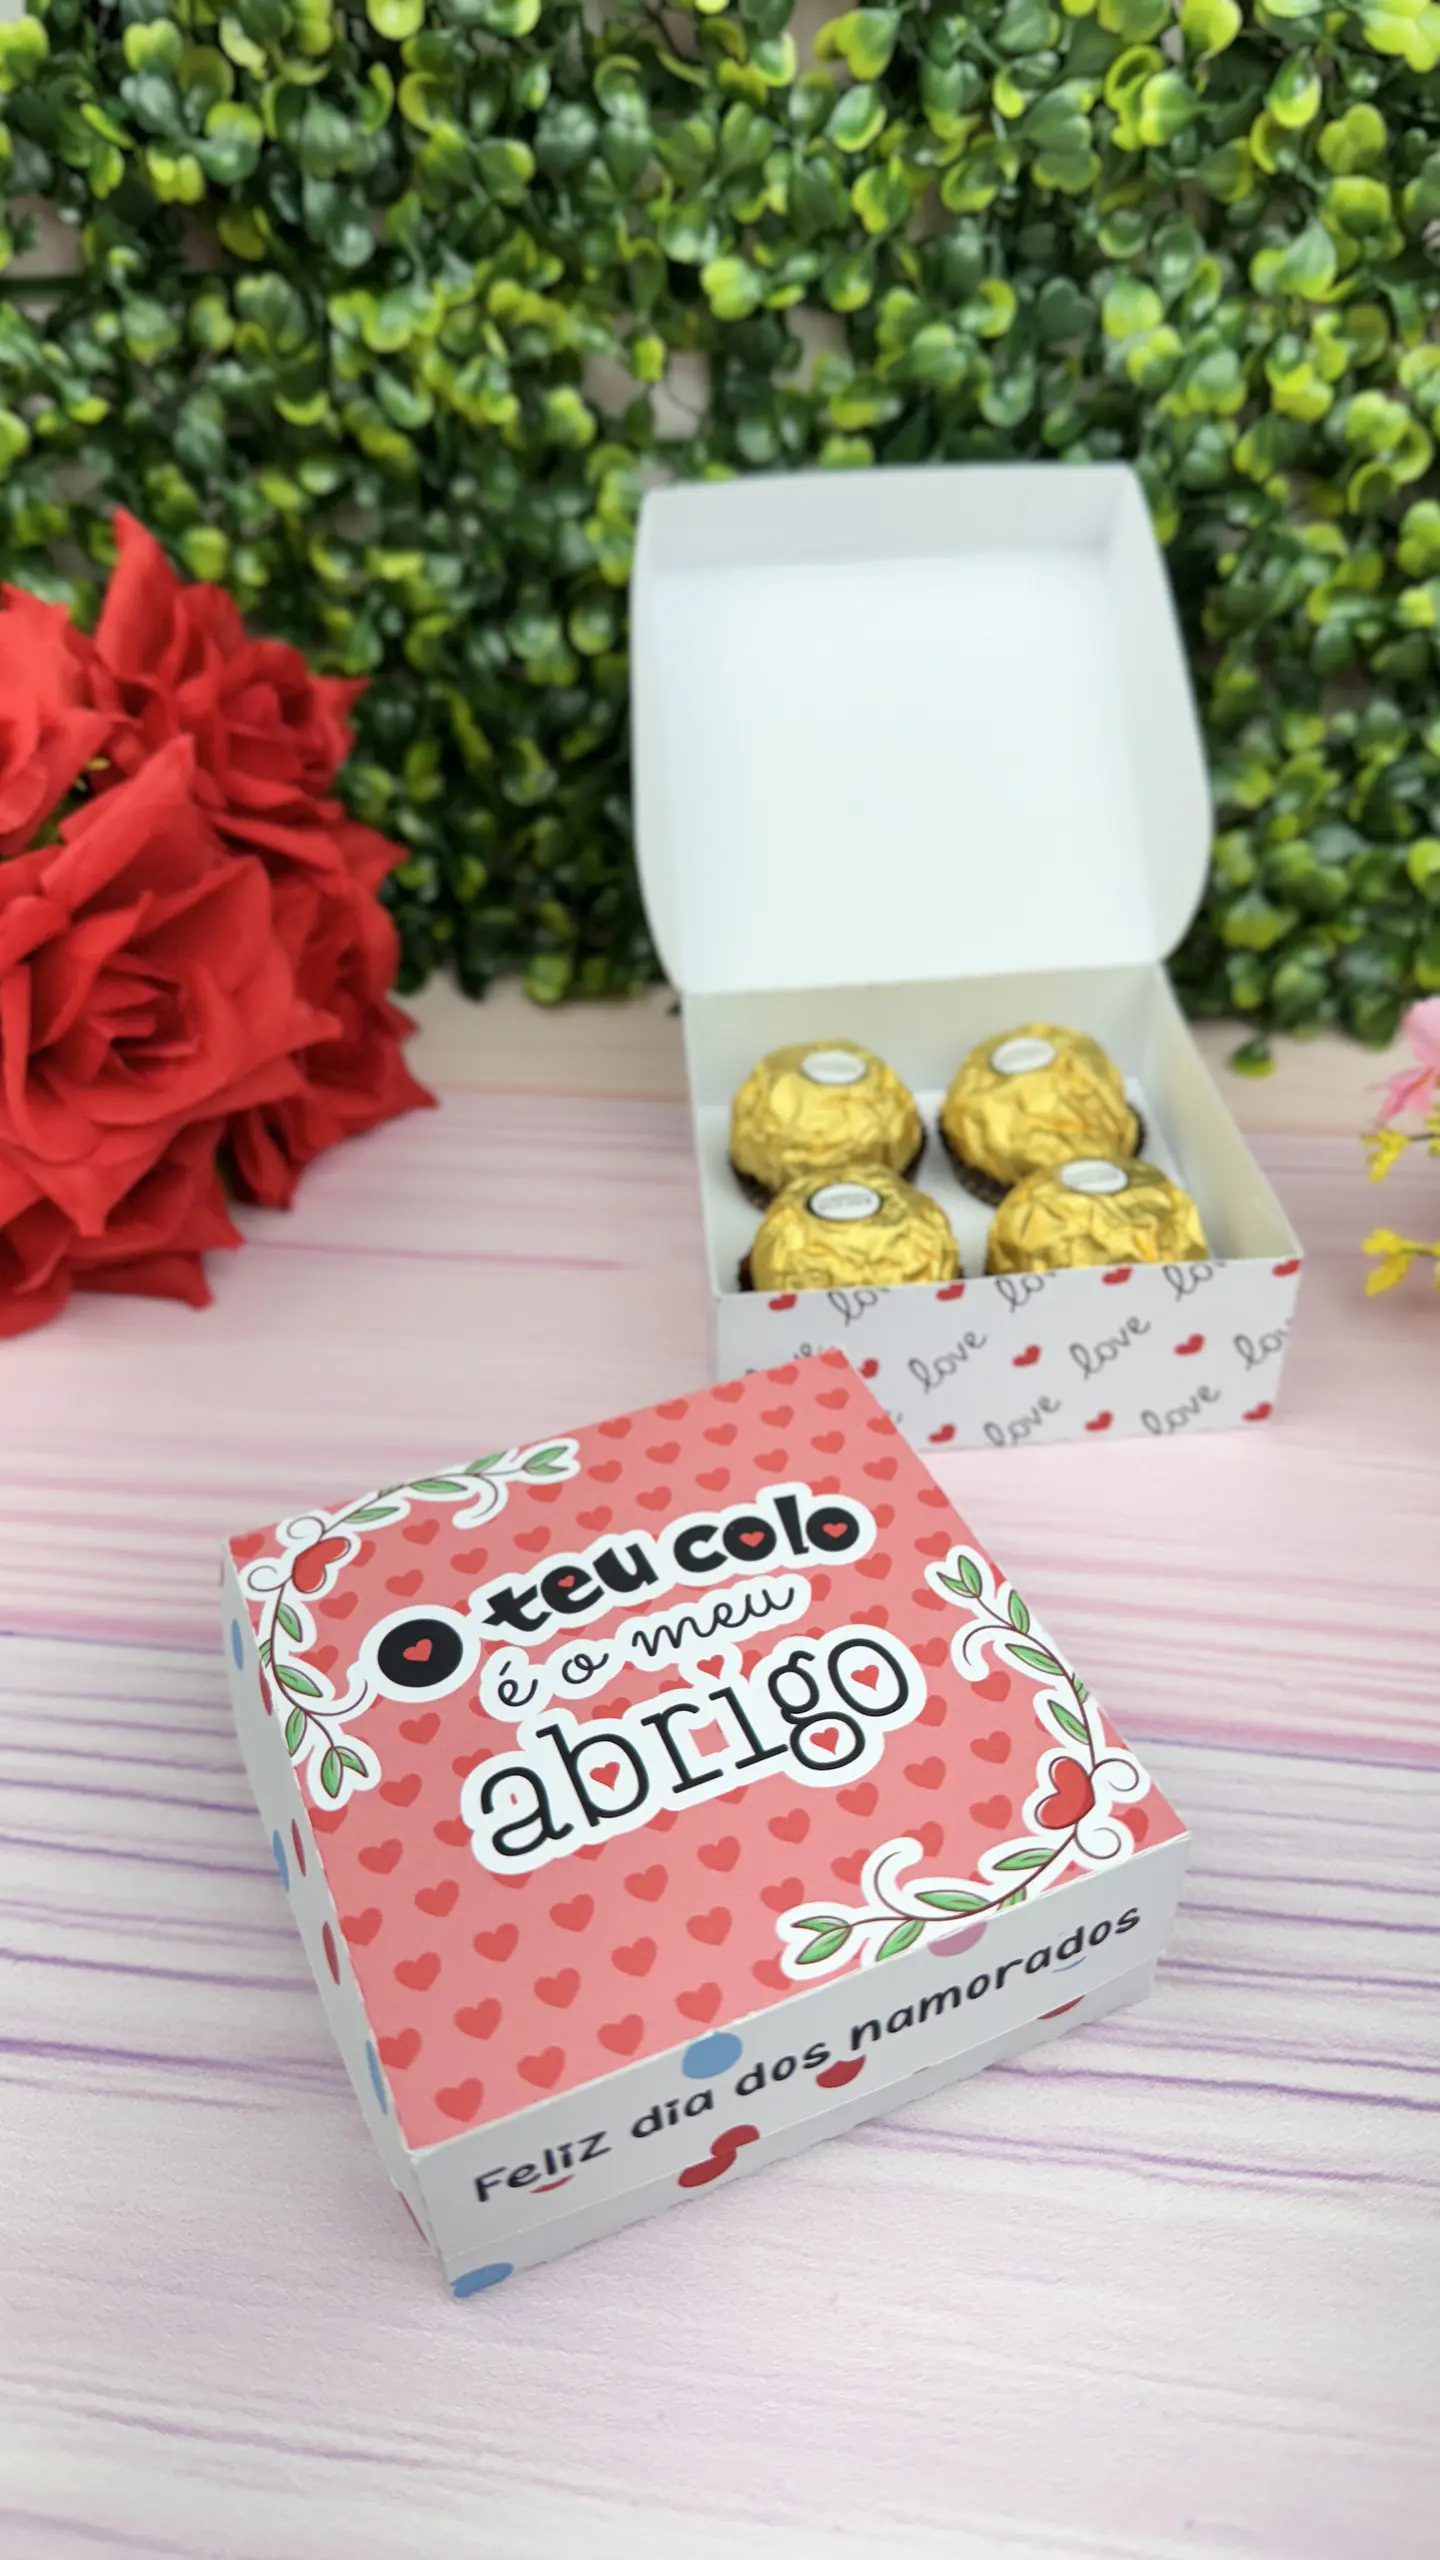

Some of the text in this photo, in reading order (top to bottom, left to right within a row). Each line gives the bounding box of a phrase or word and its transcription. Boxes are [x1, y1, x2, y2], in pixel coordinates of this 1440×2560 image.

[827, 1285, 890, 1327] lo
[994, 1272, 1056, 1314] lo
[1161, 1260, 1228, 1302] lo
[908, 1330, 987, 1394] love
[1069, 1316, 1151, 1381] love
[983, 1395, 1062, 1447] love
[1140, 1384, 1221, 1437] love
[377, 1494, 860, 1688] O teu colo
[498, 1586, 794, 1707] é o meu
[480, 1637, 909, 1857] abrigo
[474, 2130, 612, 2202] Feliz
[735, 2042, 831, 2096] dos
[850, 1906, 1142, 2051] namorados
